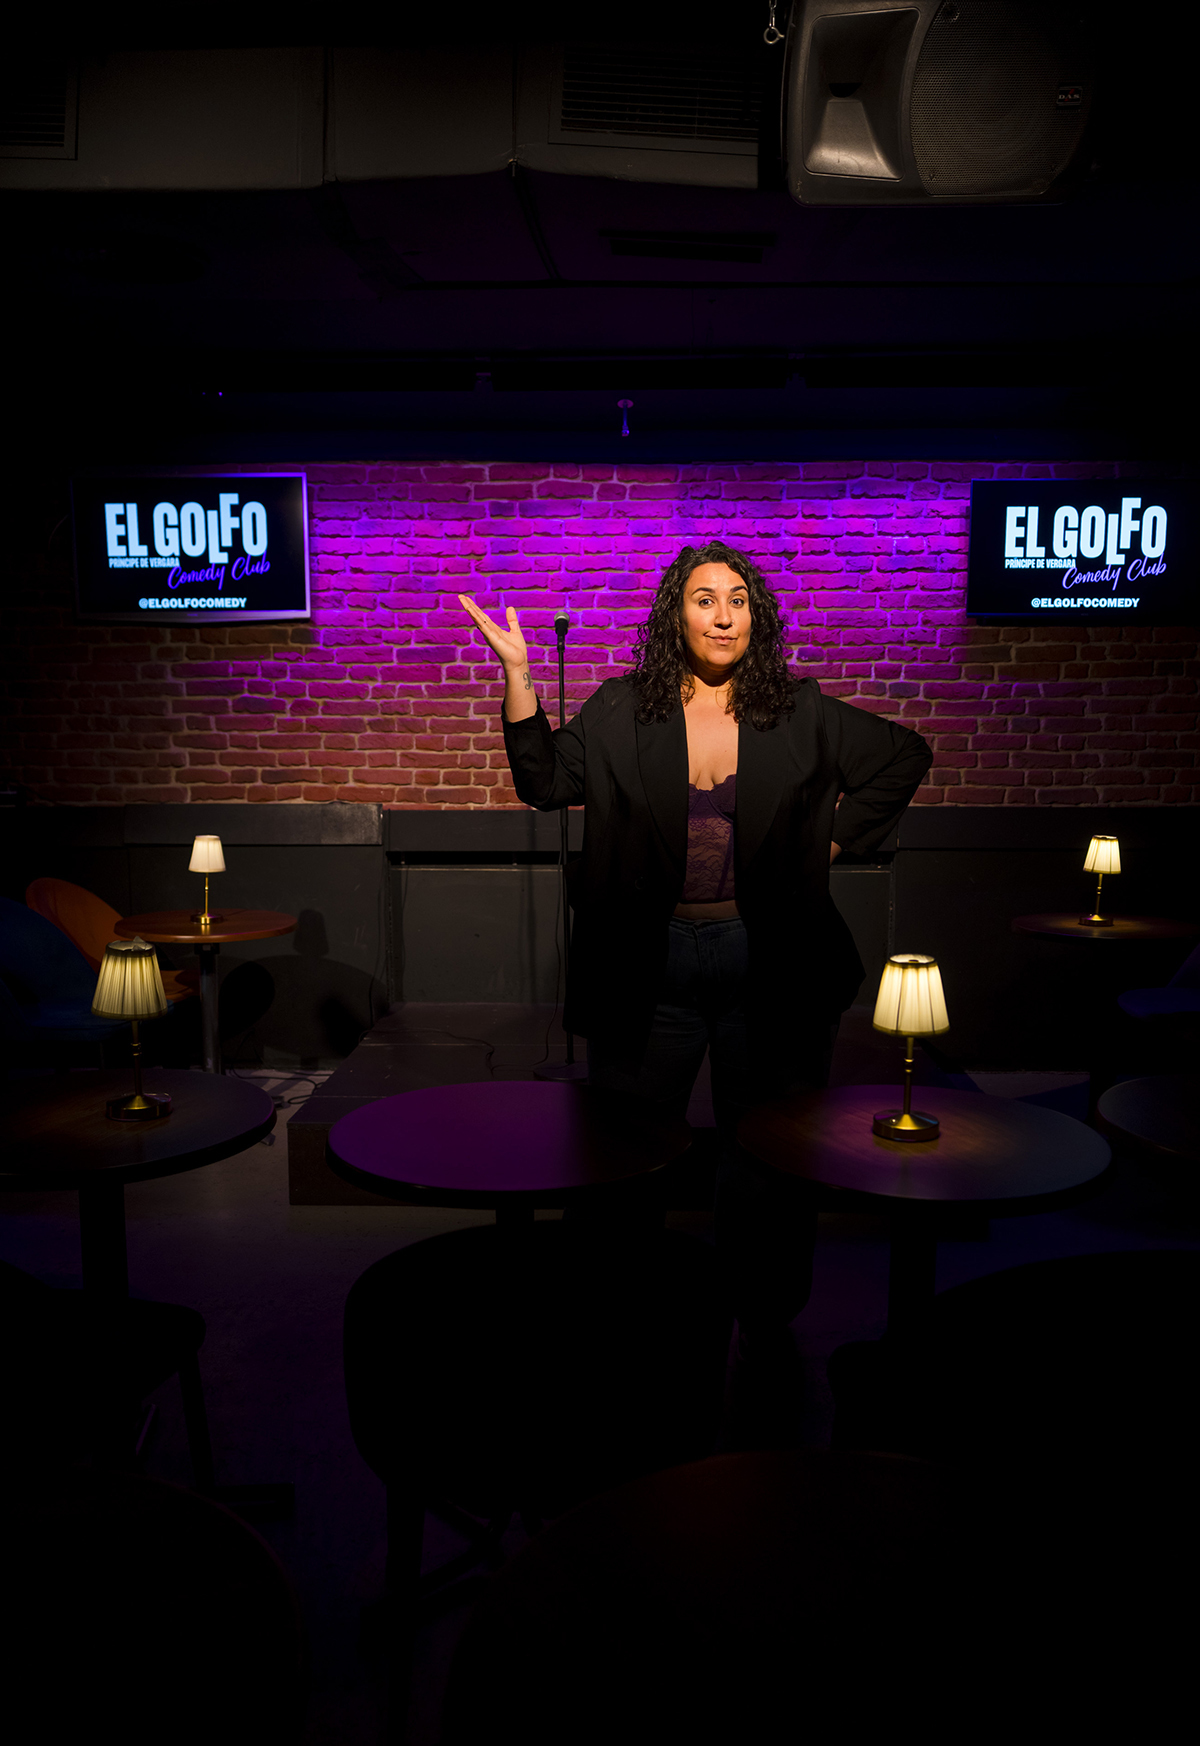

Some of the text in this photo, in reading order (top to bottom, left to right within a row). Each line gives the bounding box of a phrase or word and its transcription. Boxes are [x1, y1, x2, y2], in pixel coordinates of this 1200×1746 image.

[104, 493, 268, 564] EL GOLFO
[1004, 497, 1168, 565] EL GOLFO
[140, 557, 149, 568] DE
[149, 557, 180, 568] VERGARA
[167, 550, 271, 590] Comedy Club
[1036, 559, 1045, 569] DE
[1046, 559, 1076, 569] VERGARA
[1062, 552, 1167, 591] Comedy Club
[138, 597, 247, 609] @ELGOLFOCOMEDY
[1031, 598, 1140, 608] @ELGOLFOCOMEDY
